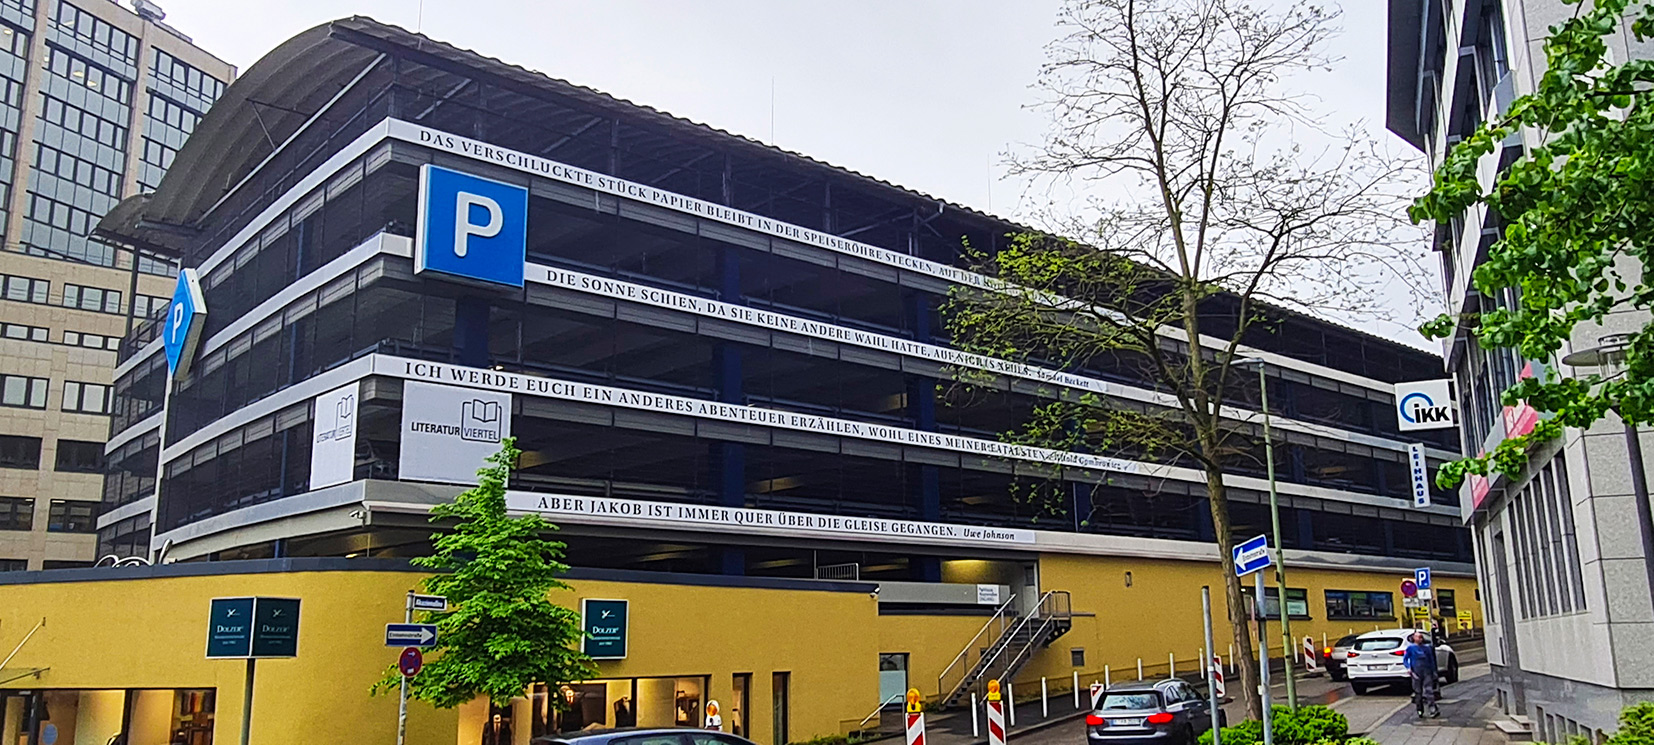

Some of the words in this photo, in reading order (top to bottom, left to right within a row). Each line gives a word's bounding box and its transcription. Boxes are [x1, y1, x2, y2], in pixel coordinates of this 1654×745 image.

[420, 130, 454, 149] DAS
[461, 141, 593, 185] VERSCHLUCKTE
[598, 176, 647, 199] STÜCK
[652, 191, 702, 213] PAPIER
[707, 205, 753, 227] BLEIBT
[758, 219, 772, 231] IN
[776, 223, 800, 239] DER
[804, 230, 882, 260] SPEISERÖHRE
[885, 252, 936, 274] STECKEN,
[939, 266, 958, 280] AUF
[454, 190, 504, 257] P
[172, 302, 184, 344] P
[547, 270, 576, 286] DIE
[582, 277, 636, 298] SONNE
[641, 289, 702, 312] SCHIEN,
[707, 303, 726, 316] DA
[731, 307, 752, 321] SIE
[757, 312, 797, 330] KEINE
[801, 322, 851, 341] ANDERE
[855, 332, 888, 348] WAHL
[891, 340, 931, 357] HATTE,
[934, 350, 954, 362] AUF
[405, 362, 442, 379] ICH
[451, 368, 519, 389] WERDE
[526, 379, 576, 397] EUCH
[583, 387, 612, 402] EIN
[619, 392, 693, 413] ANDERES
[698, 403, 786, 425] ABENTEUER
[791, 415, 864, 436] ERZÄHLEN,
[868, 426, 904, 441] WOHL
[908, 431, 941, 446] EINES
[945, 437, 987, 452] MEINER
[411, 422, 461, 437] LITERATUR
[463, 427, 498, 441] VIERTEL
[1412, 446, 1425, 504] LEIHHAUS
[538, 496, 584, 511] ABER
[590, 500, 642, 515] JAKOB
[648, 504, 673, 517] IST
[678, 506, 730, 522] IMMER
[734, 511, 773, 526] QUER
[778, 512, 814, 527] ÜBER
[818, 517, 840, 529] DIE
[844, 519, 888, 532] GLEISE
[891, 523, 957, 537] GEGANGEN.
[963, 528, 981, 539] Uwe
[983, 529, 1015, 541] Johnson
[1418, 571, 1427, 587] P
